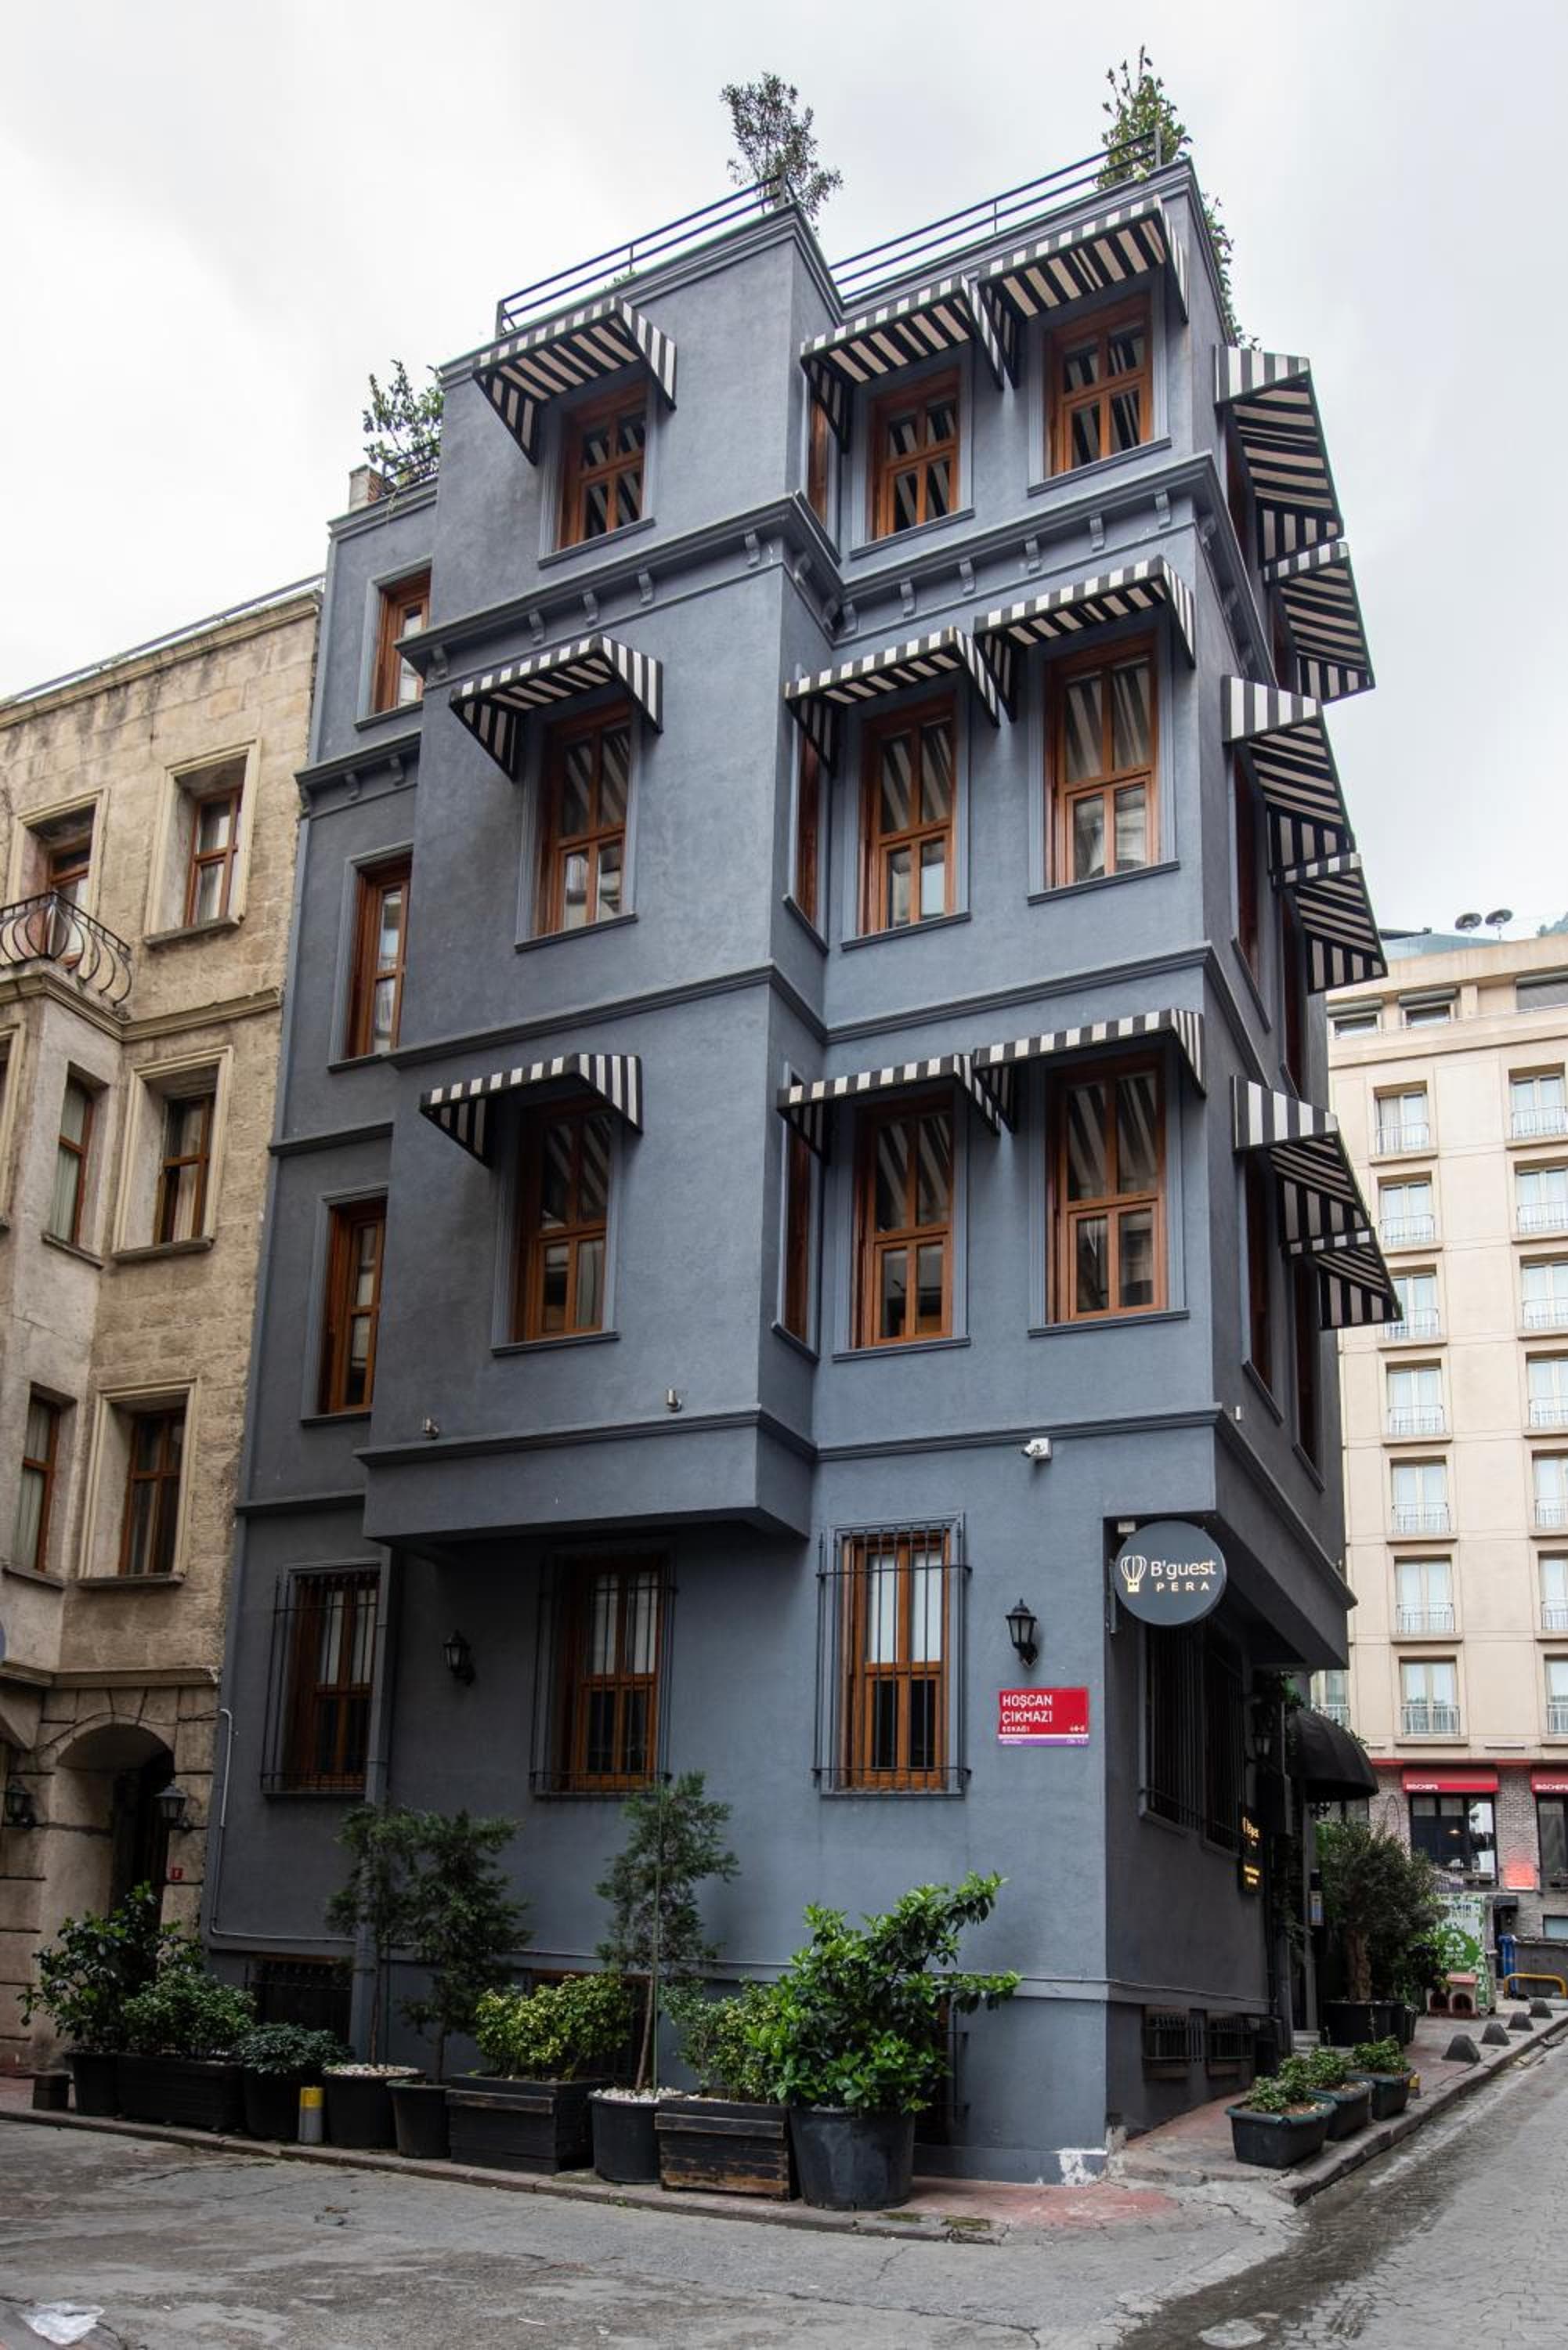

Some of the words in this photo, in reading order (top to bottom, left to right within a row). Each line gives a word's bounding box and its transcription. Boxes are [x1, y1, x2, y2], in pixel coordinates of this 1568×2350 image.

[1151, 1560, 1216, 1579] B'guest
[1156, 1582, 1210, 1592] PERA
[1003, 1694, 1053, 1708] HOŞCAN
[1002, 1710, 1053, 1723] ÇIKMAZI
